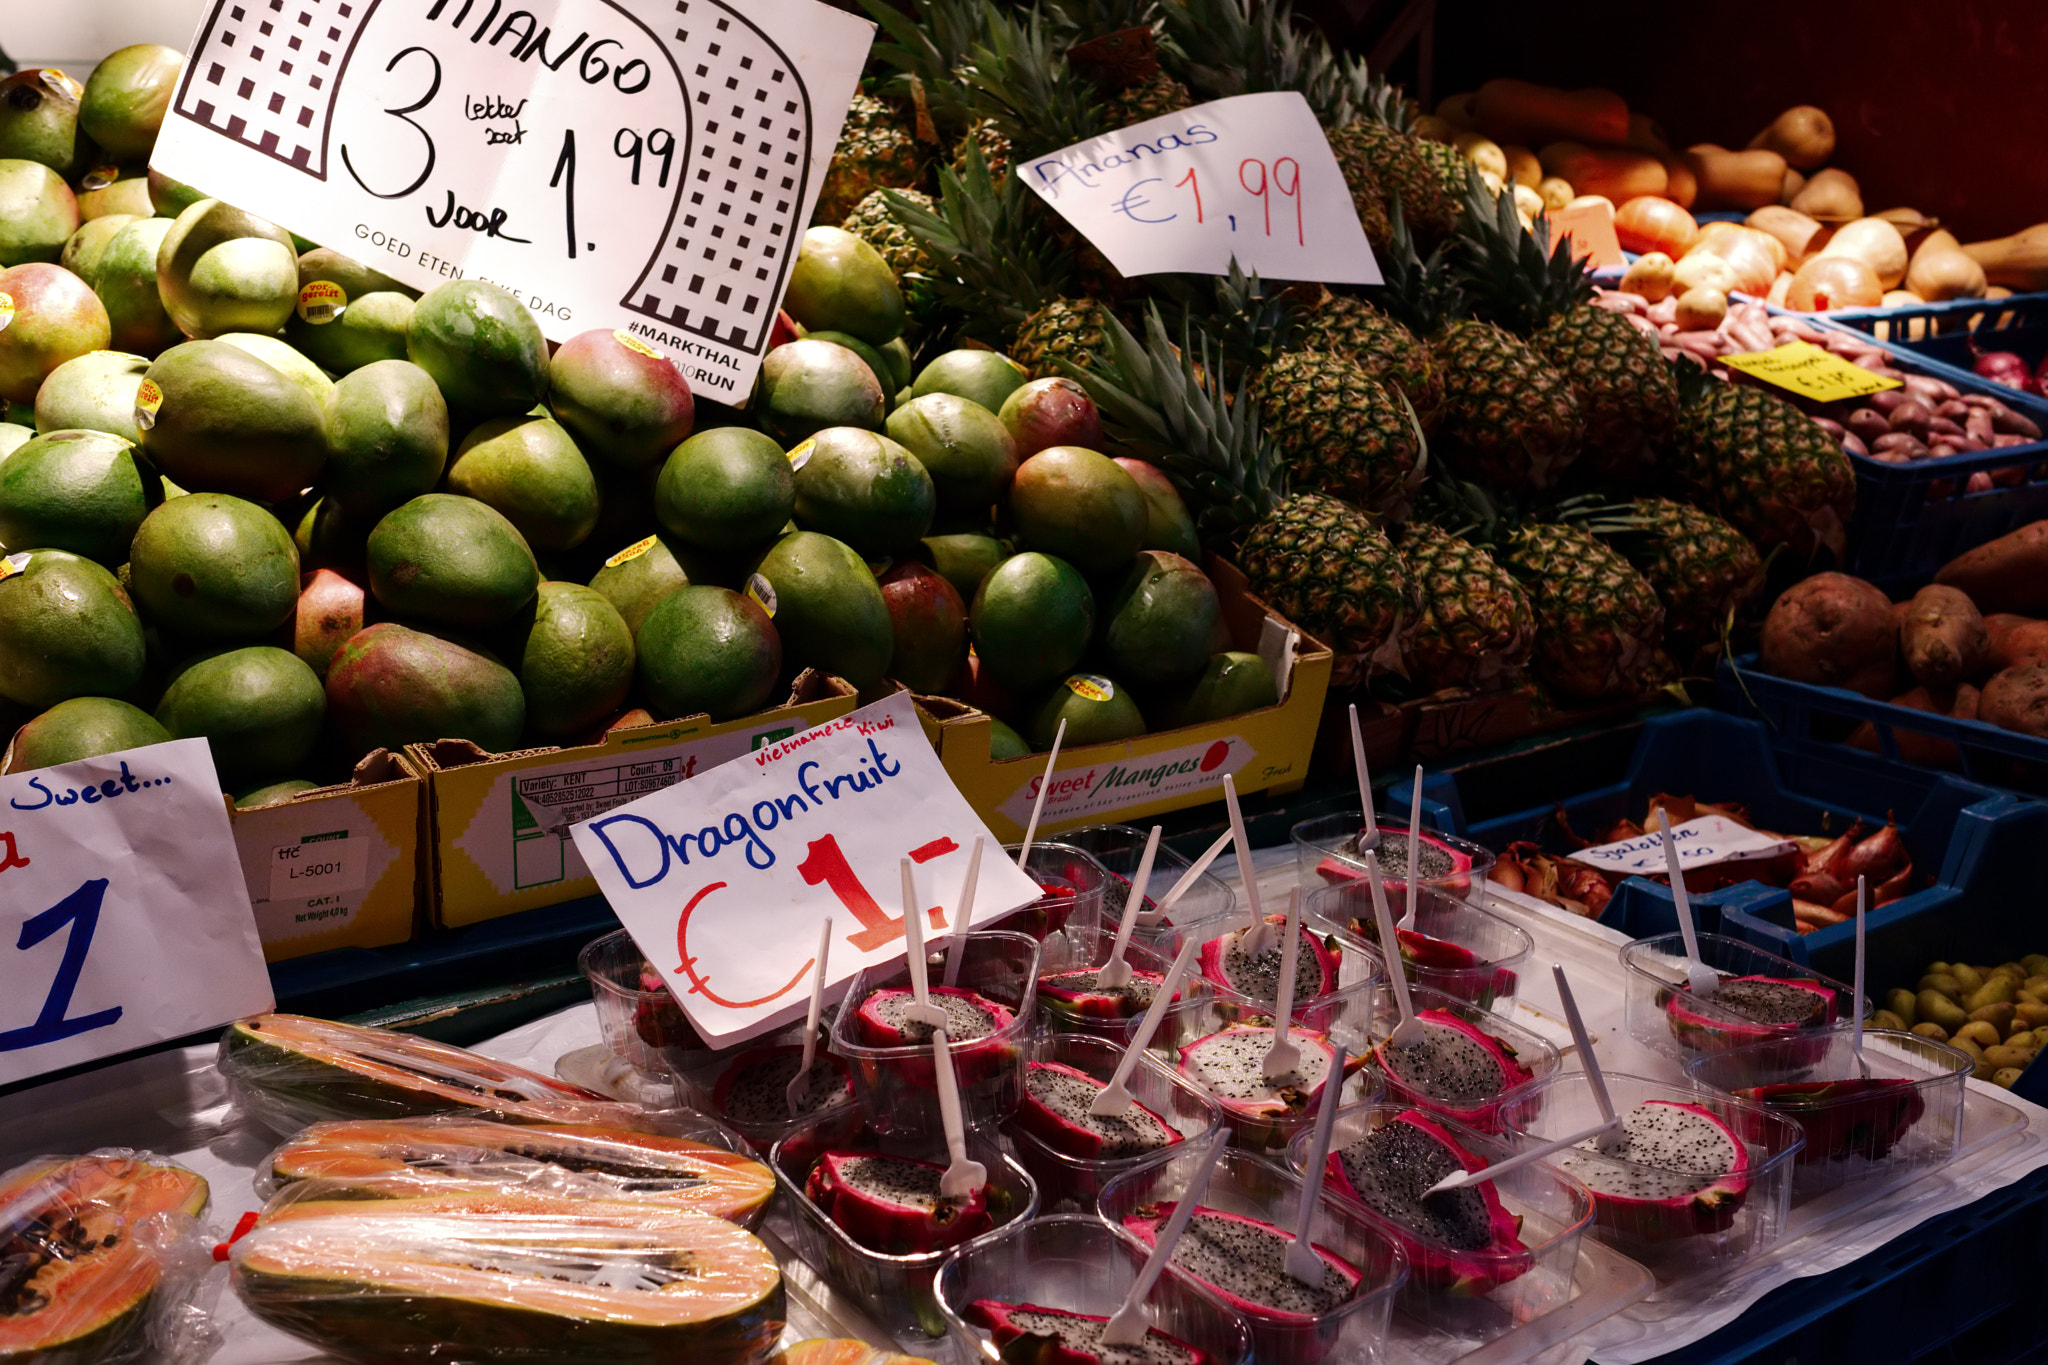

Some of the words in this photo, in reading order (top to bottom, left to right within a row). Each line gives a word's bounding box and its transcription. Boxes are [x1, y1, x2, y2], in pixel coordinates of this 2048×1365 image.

[341, 46, 442, 199] 3
[1034, 124, 1218, 199] Ananas
[355, 223, 411, 258] GOED
[529, 296, 572, 321] DAG
[628, 321, 742, 371] #MARKTHAL
[524, 779, 557, 792] Variety:
[564, 772, 587, 786] KENT
[630, 764, 657, 776] Count:
[663, 760, 673, 772] 09
[1026, 770, 1095, 800] Sweet
[1088, 757, 1201, 798] Mangoes
[589, 738, 901, 890] Dragonfruit
[290, 861, 341, 879] L-5001
[307, 897, 334, 907] CAT.
[307, 908, 329, 922] Weight
